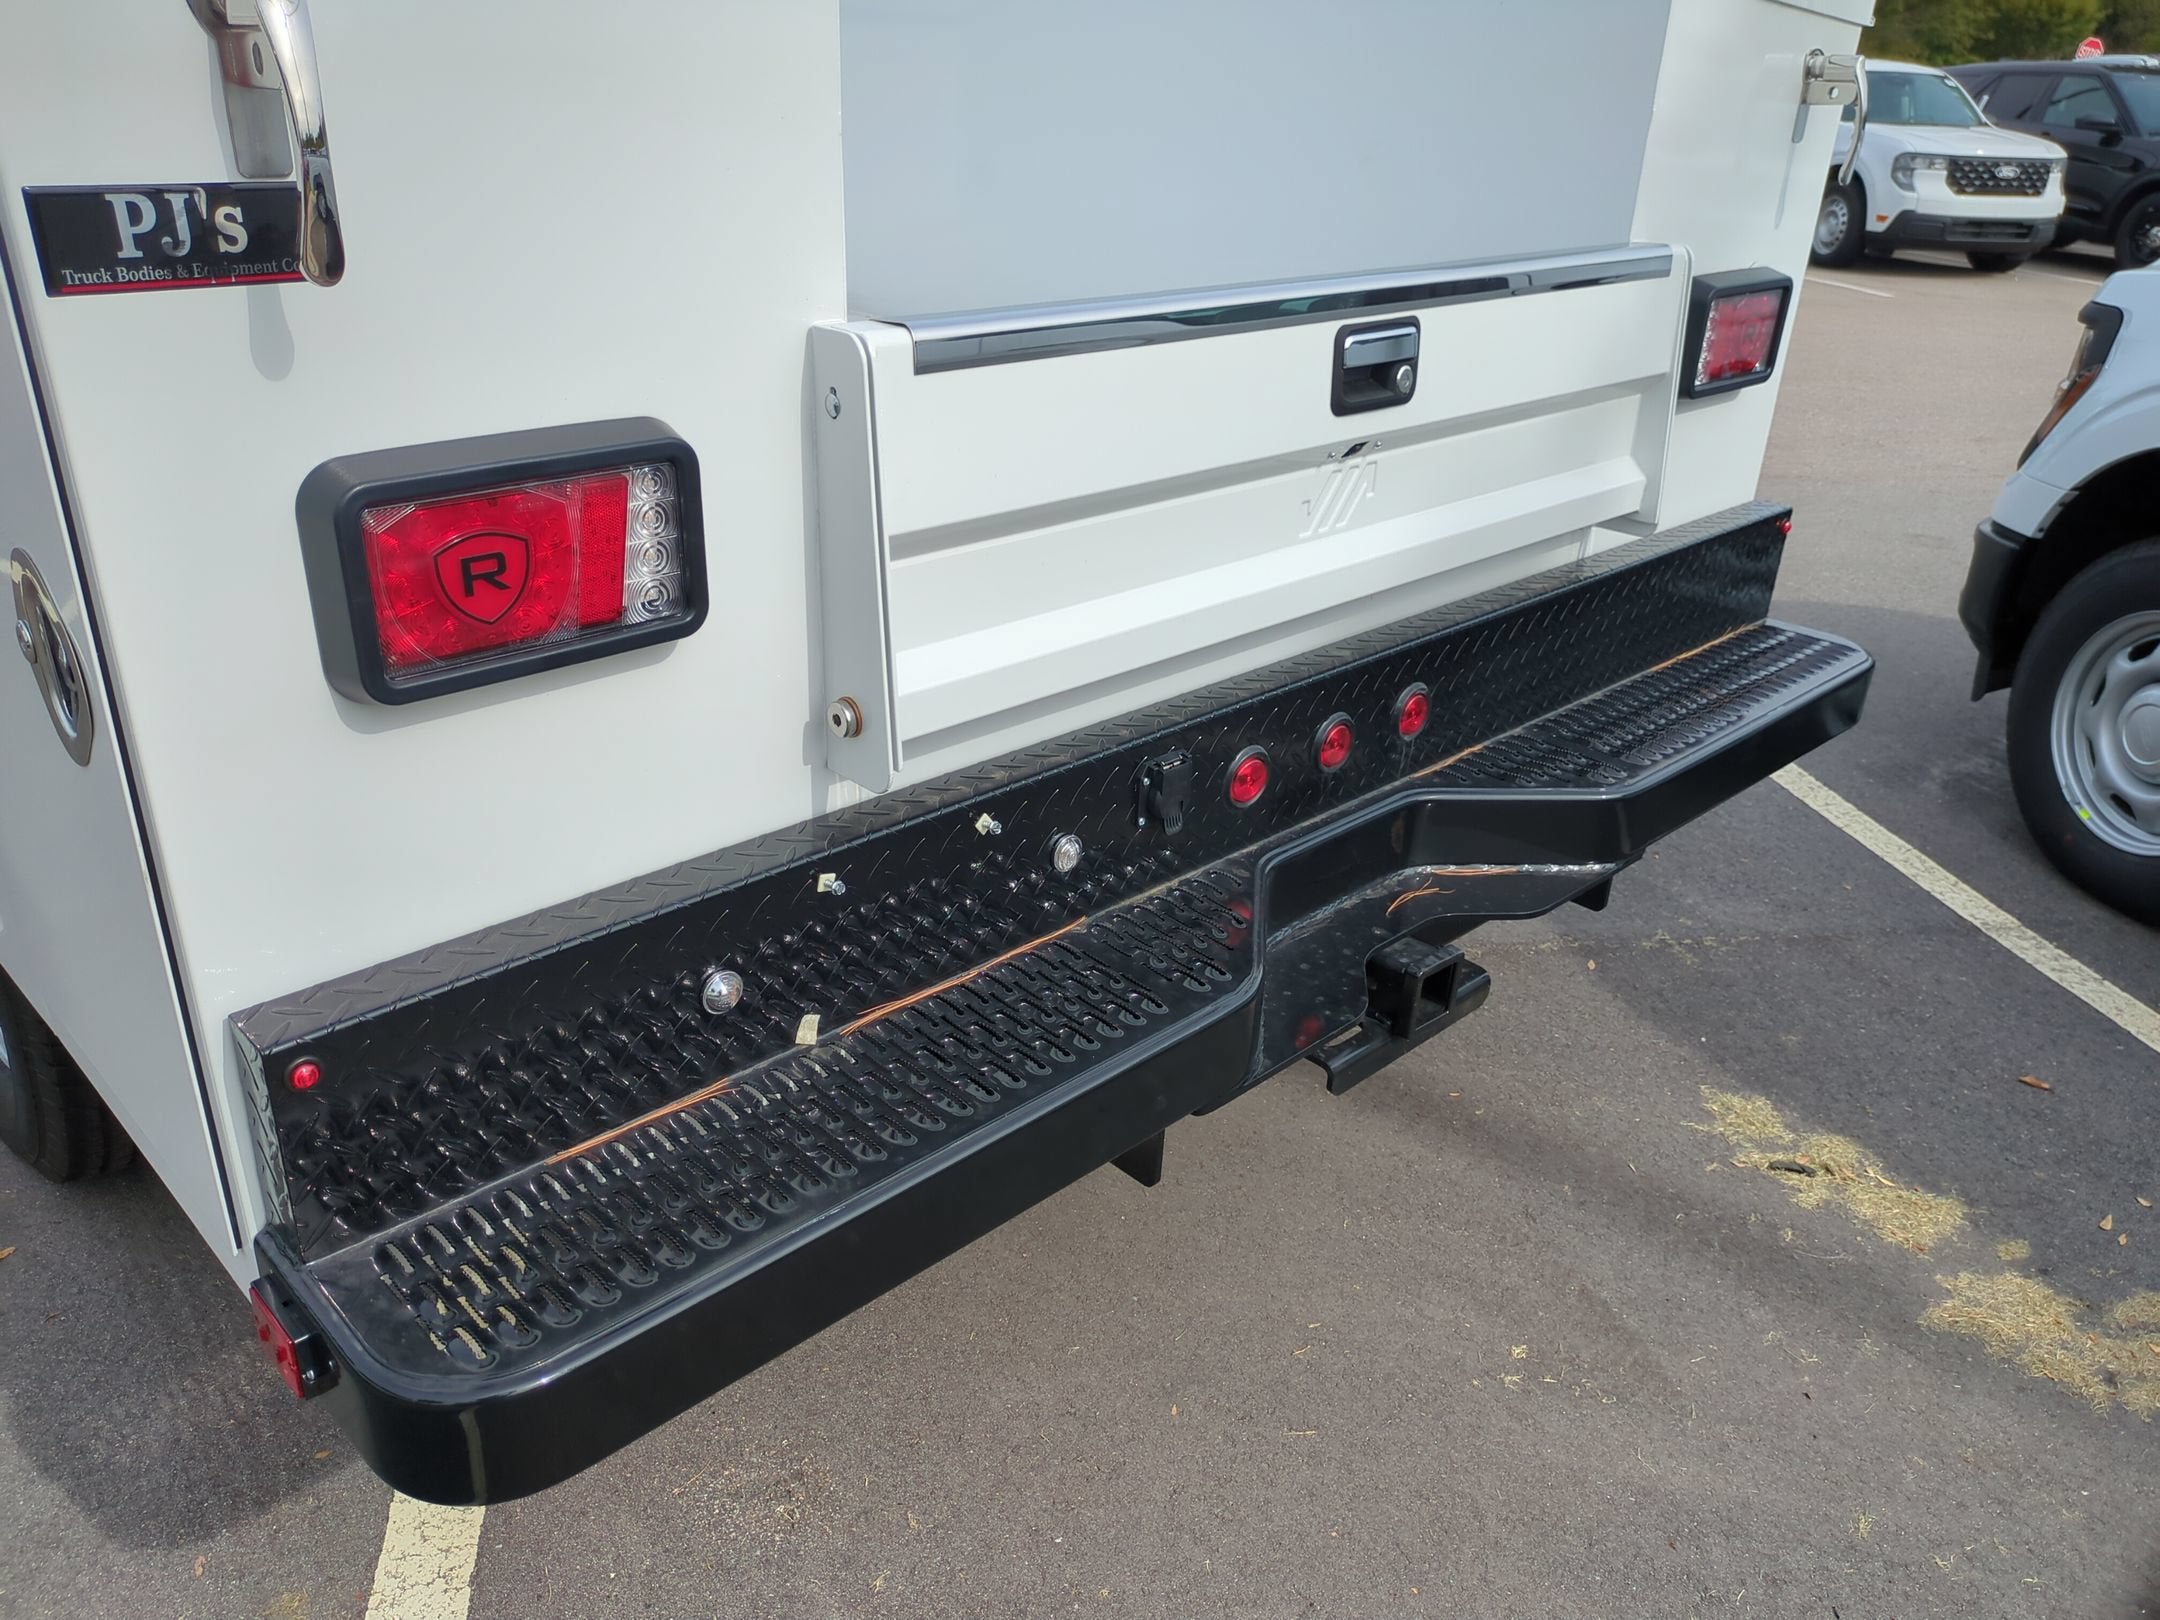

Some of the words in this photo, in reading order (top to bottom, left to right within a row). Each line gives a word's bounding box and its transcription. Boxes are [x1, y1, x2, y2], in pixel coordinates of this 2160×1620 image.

[104, 187, 249, 258] PJ's
[61, 268, 114, 285] Truck
[115, 266, 172, 282] Bodies
[177, 264, 189, 279] &
[192, 259, 279, 284] Eqipment
[460, 551, 512, 598] R
